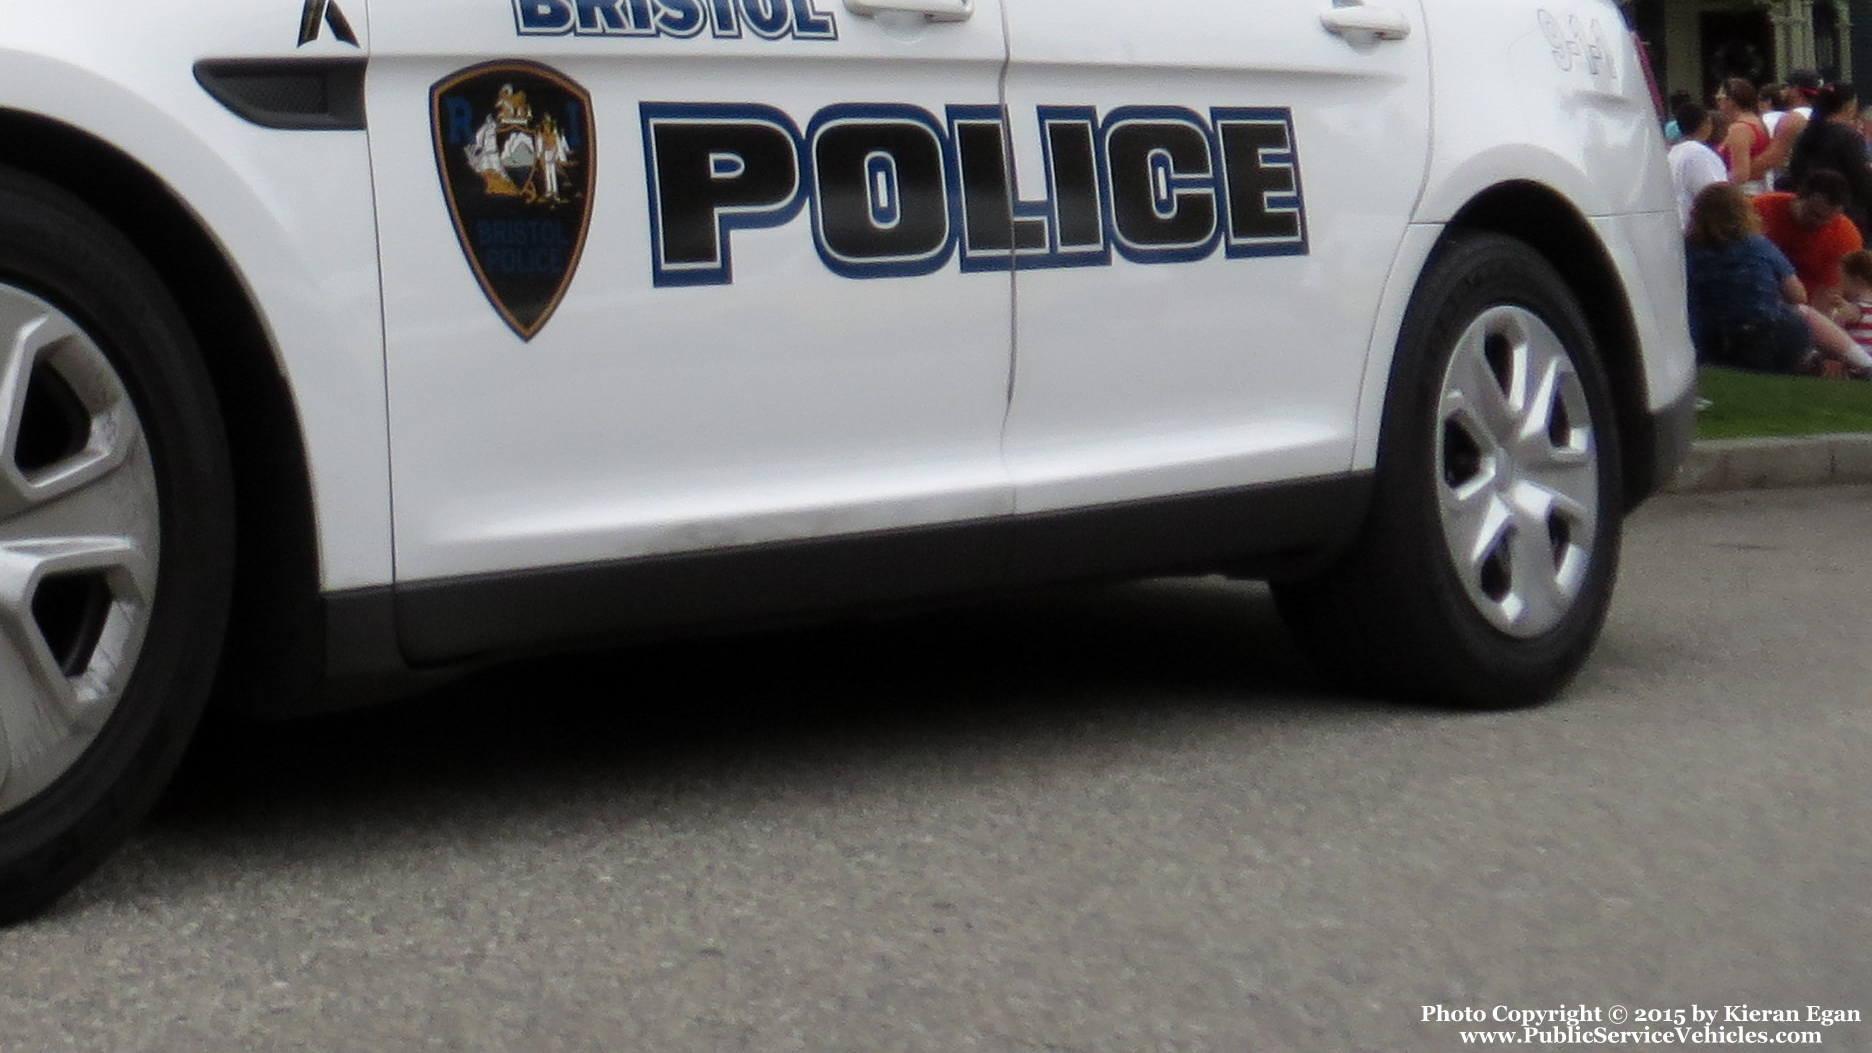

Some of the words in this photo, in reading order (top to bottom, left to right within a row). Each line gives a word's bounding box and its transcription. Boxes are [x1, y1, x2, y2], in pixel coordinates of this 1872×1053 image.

[445, 97, 473, 143] R
[640, 101, 1309, 287] POLICE
[478, 219, 568, 243] BRISTOL
[485, 248, 562, 274] POLICE
